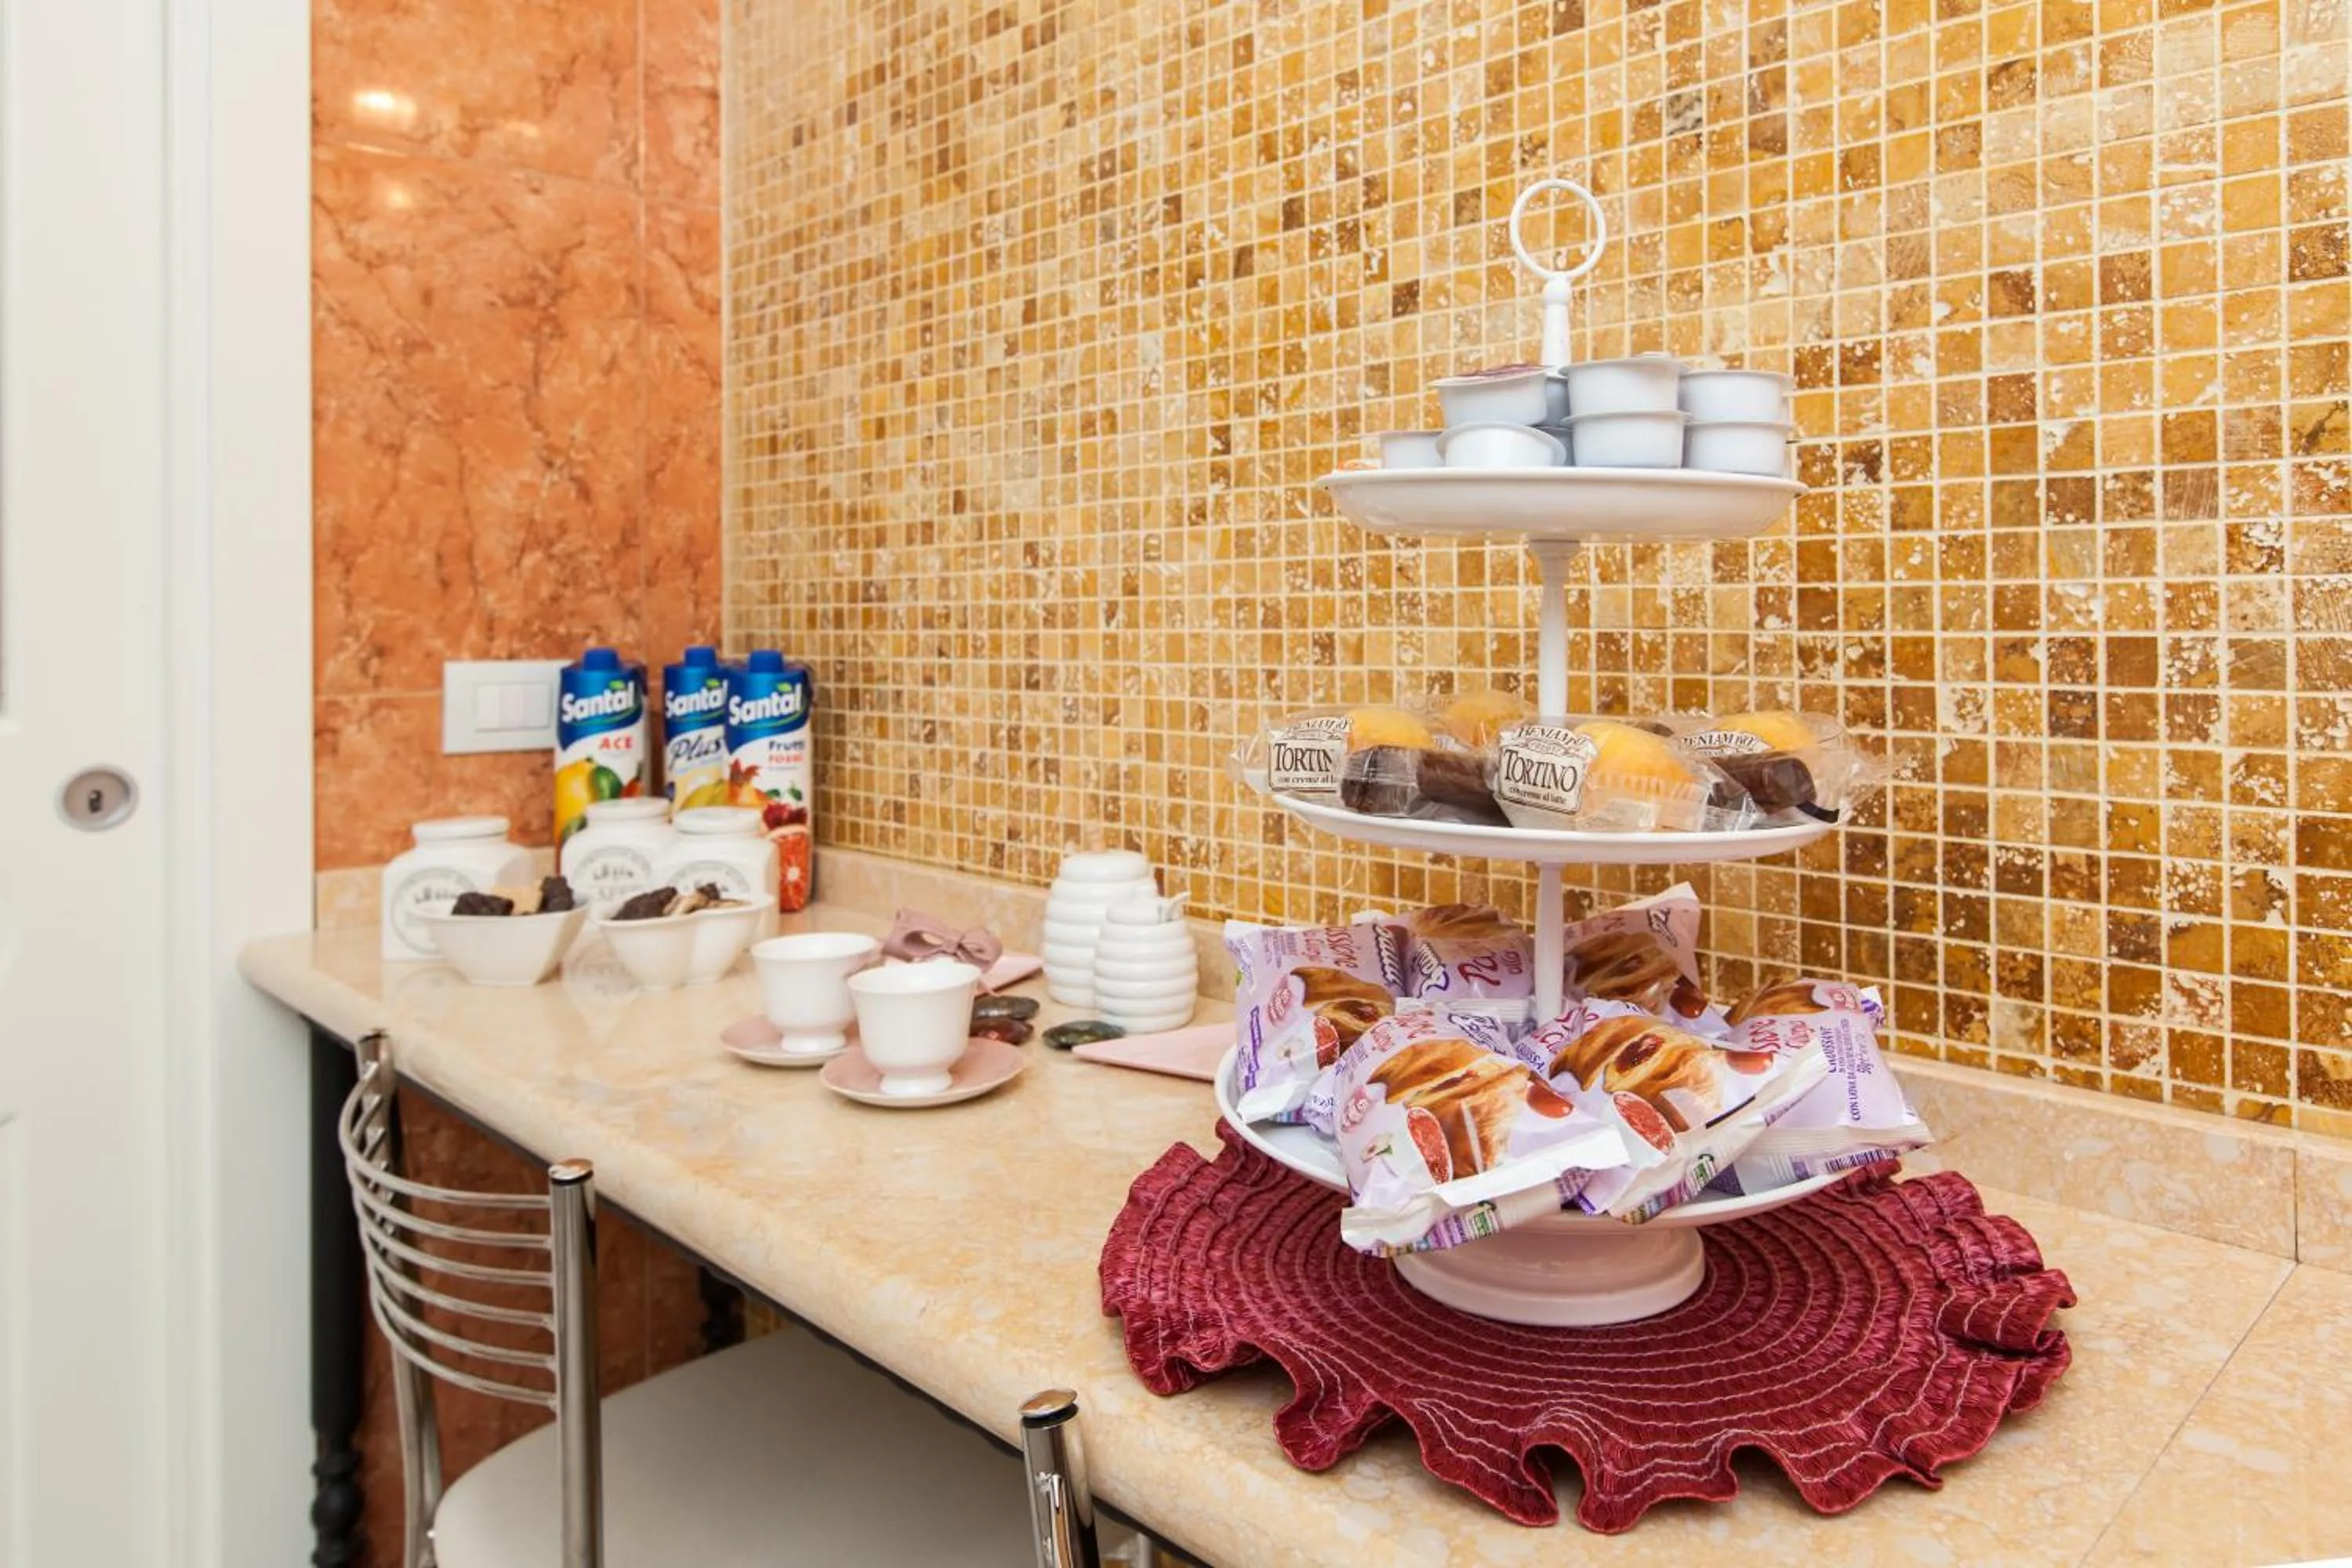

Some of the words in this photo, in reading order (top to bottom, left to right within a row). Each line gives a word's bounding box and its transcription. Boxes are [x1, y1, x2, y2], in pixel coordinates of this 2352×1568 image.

[599, 735, 634, 750] ACE
[670, 735, 722, 770] Plus
[1273, 742, 1334, 772] TORTIN
[1504, 749, 1578, 793] TORTINO
